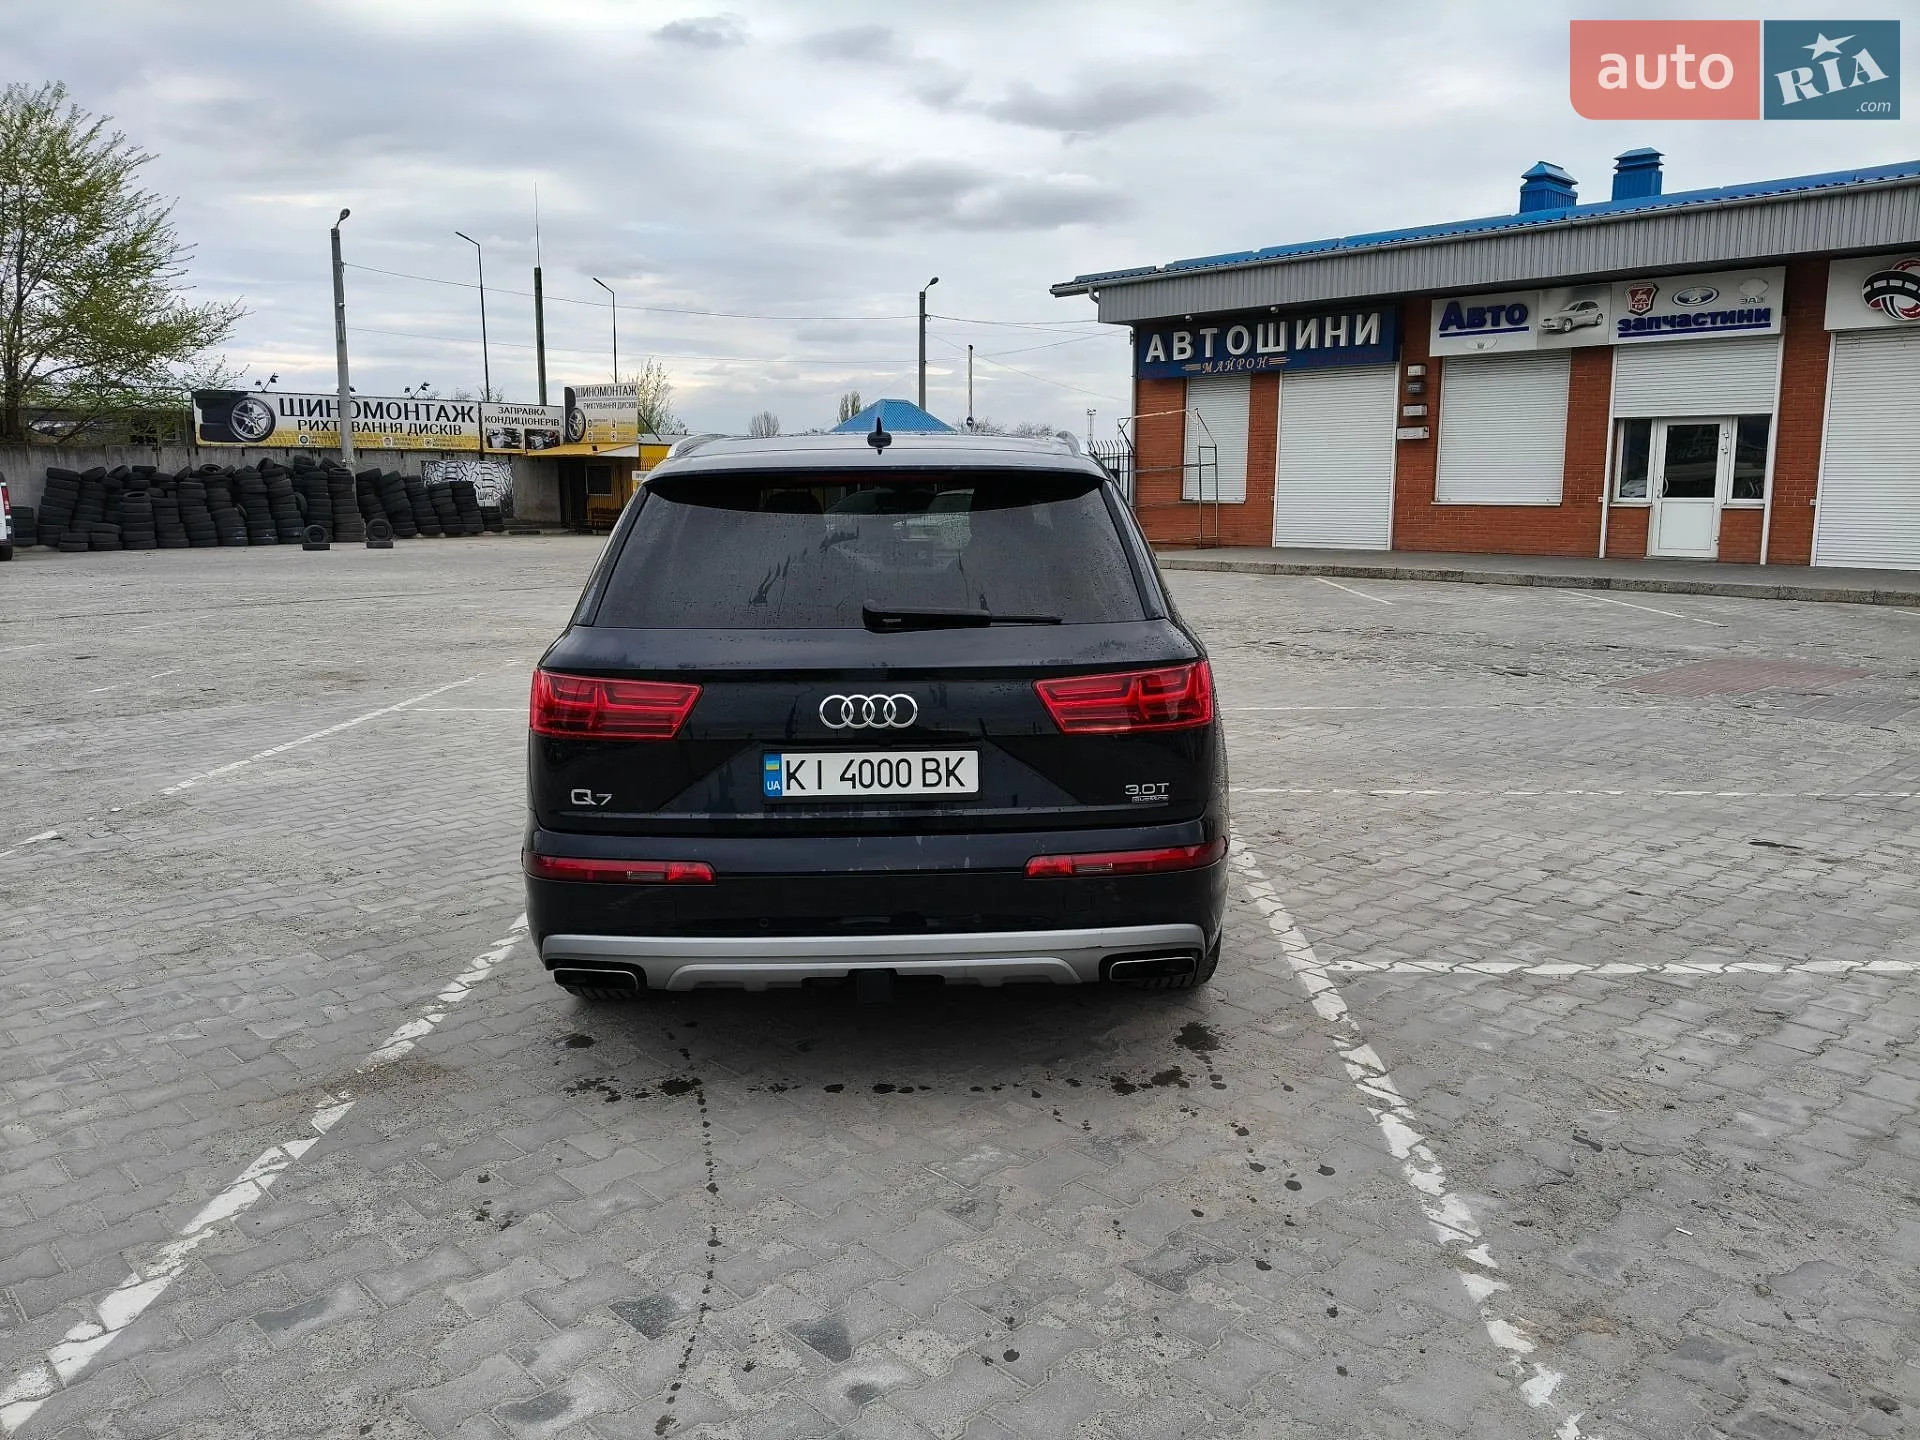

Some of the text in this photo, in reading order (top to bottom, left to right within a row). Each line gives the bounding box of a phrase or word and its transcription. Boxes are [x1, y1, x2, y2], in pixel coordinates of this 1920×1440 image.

[1617, 308, 1771, 332] запчастини
[1145, 313, 1381, 363] АВТОШИНИ
[1201, 356, 1269, 374] МАЙРОН
[576, 385, 637, 398] ШИНОМОНТАЖ
[498, 406, 546, 416] ЗАПРАВКА
[297, 420, 462, 436] РИХТВАННЯ ДИСКІВ
[484, 415, 560, 427] КОНДИЦІОНЕРІВ
[786, 757, 966, 790] KI 4000 BK
[767, 781, 780, 790] UA
[571, 789, 612, 805] Q7
